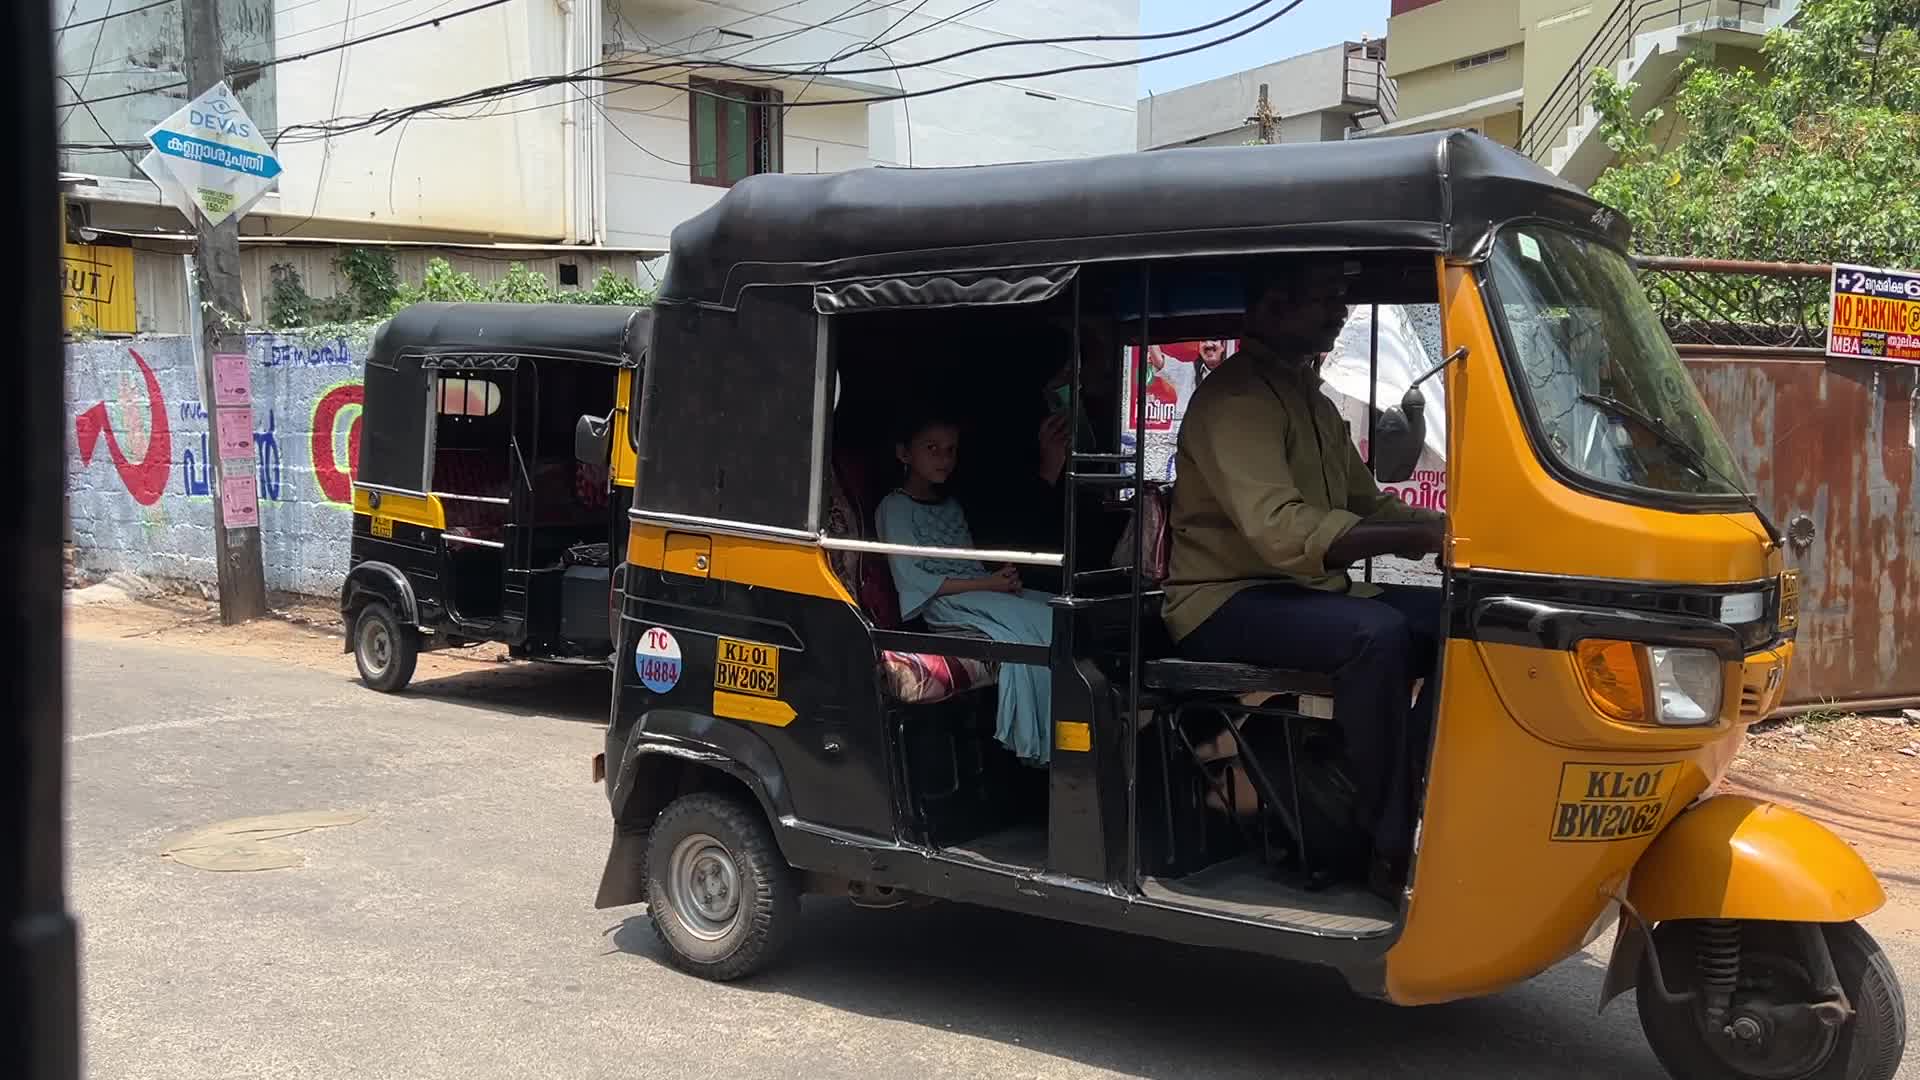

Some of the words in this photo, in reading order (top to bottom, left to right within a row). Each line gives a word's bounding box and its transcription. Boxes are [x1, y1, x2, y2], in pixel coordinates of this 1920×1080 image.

[190, 110, 250, 137] DEVAS
[1834, 296, 1852, 326] NO
[1856, 297, 1907, 332] PARKING
[1832, 335, 1860, 354] MBA
[648, 629, 668, 650] TC
[640, 657, 678, 684] 14884
[717, 663, 776, 693] BW2062
[1553, 802, 1663, 837] BW2062
